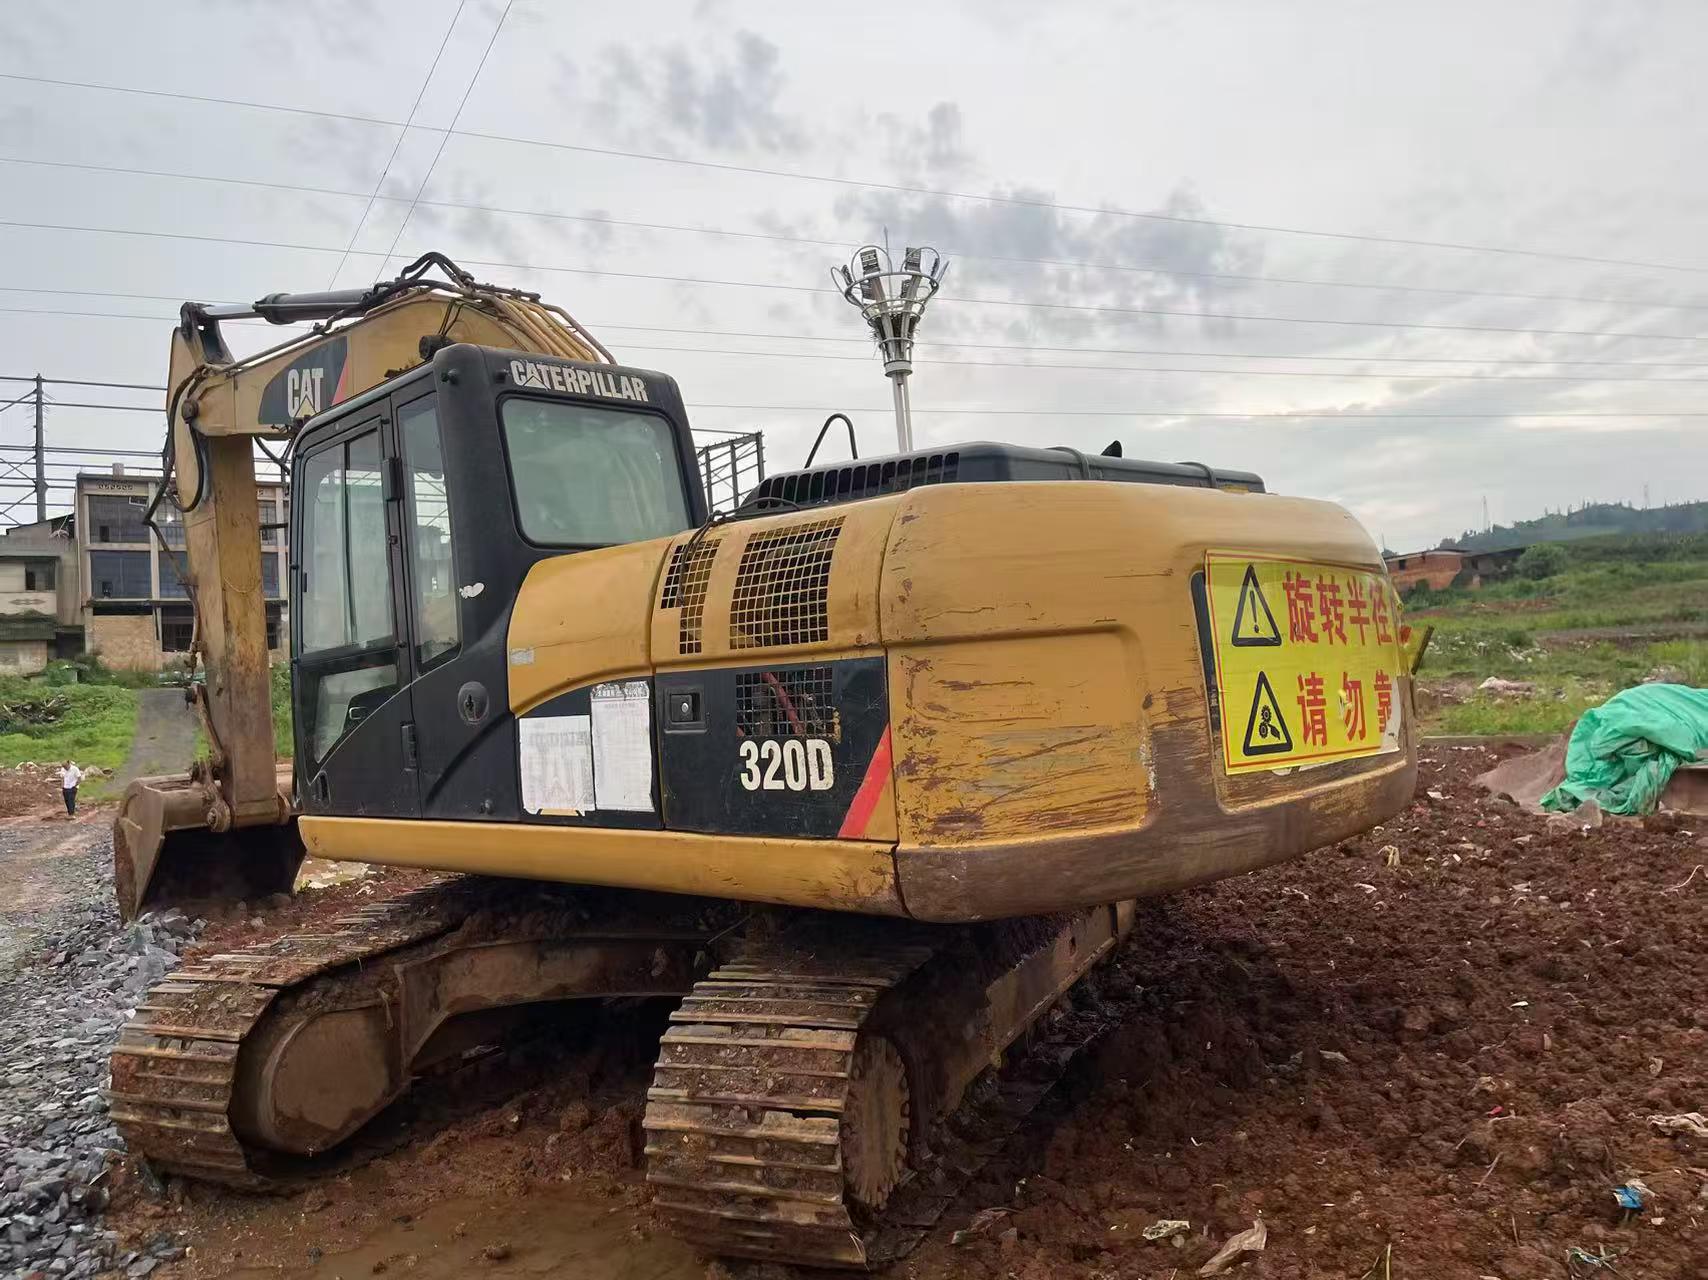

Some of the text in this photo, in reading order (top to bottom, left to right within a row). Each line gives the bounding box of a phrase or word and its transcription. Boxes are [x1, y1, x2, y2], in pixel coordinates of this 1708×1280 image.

[288, 368, 323, 418] CAT
[510, 360, 648, 402] CATERPILLAR
[739, 739, 834, 791] 320D
